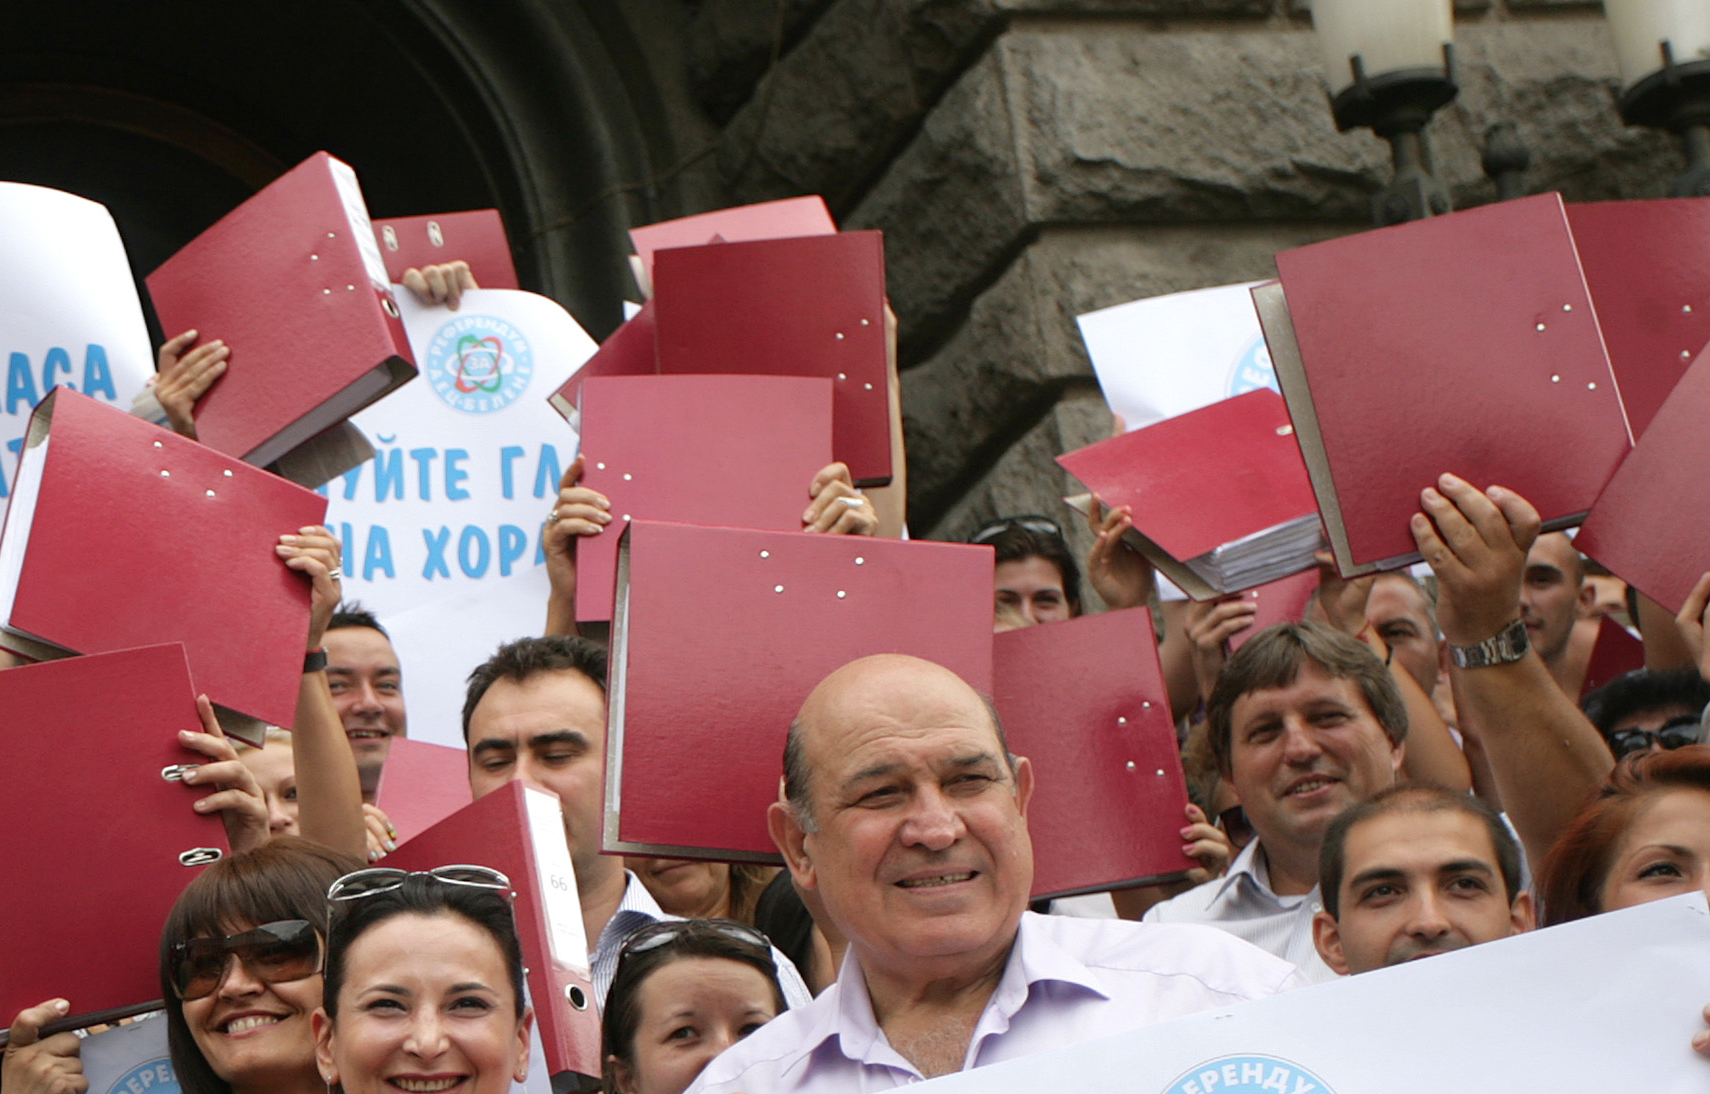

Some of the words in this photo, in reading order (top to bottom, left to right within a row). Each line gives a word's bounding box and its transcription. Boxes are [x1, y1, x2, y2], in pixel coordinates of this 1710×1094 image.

[317, 433, 470, 502] УЙТЕ
[501, 443, 562, 500] ГЛ
[550, 873, 568, 892] 66
